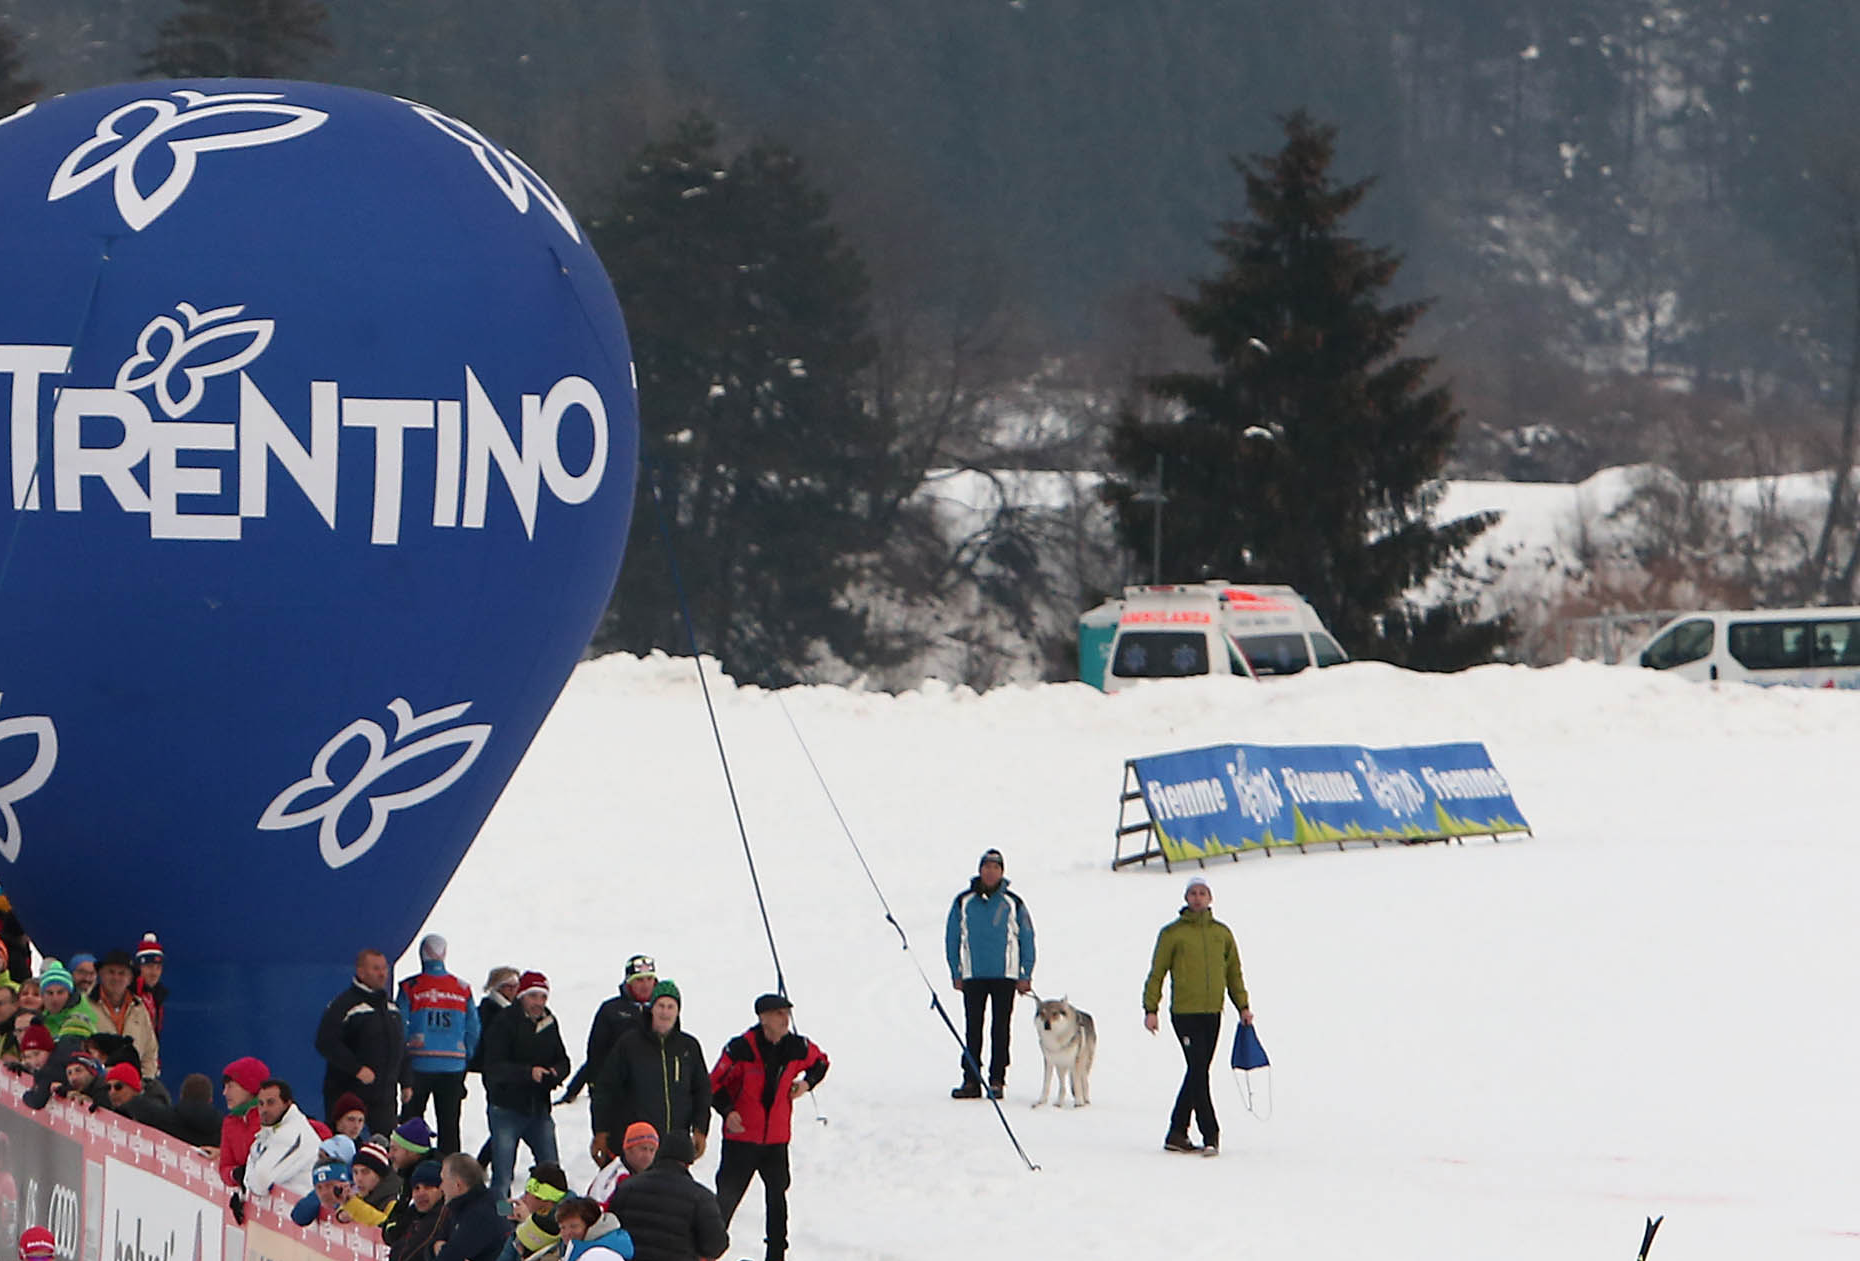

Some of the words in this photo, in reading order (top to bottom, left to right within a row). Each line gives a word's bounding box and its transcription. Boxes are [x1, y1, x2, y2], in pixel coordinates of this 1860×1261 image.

[1147, 777, 1228, 821] fiemme
[1282, 767, 1363, 803] fiemme
[1421, 767, 1510, 800] fiemme
